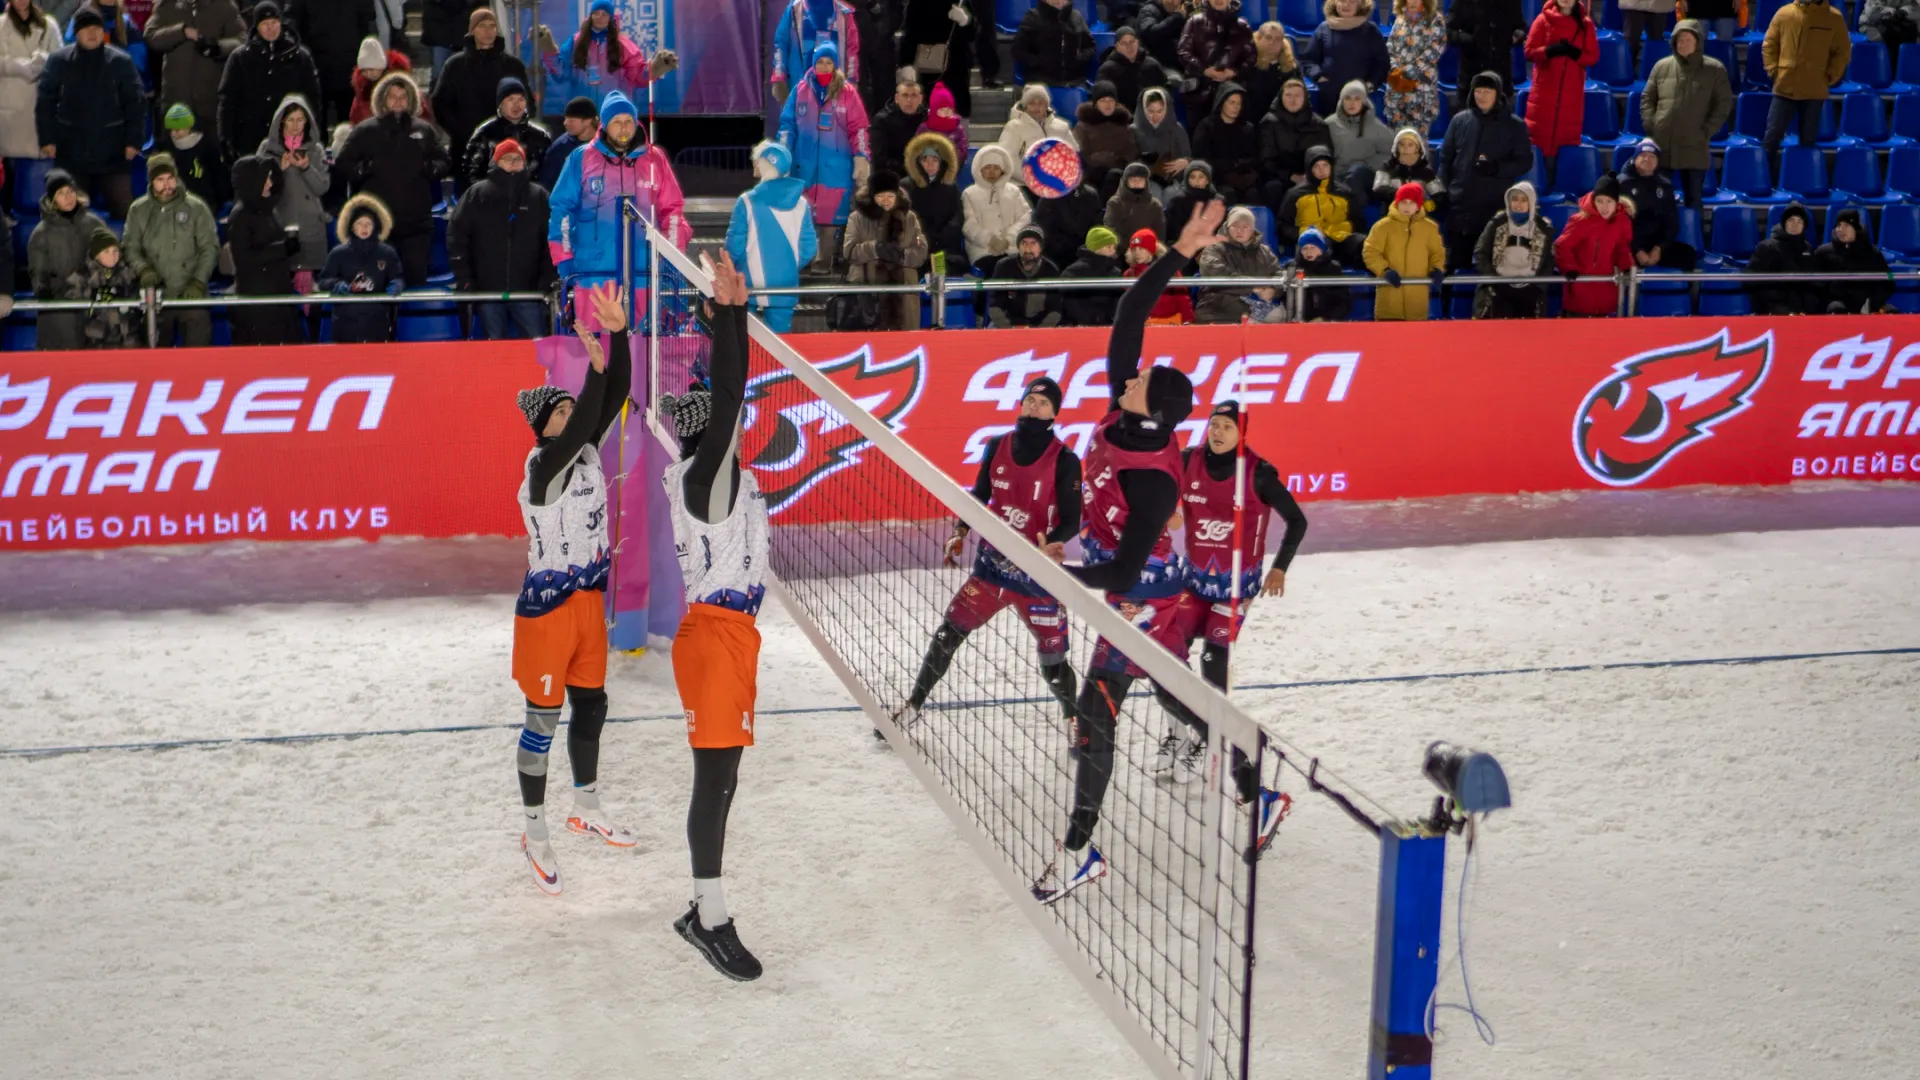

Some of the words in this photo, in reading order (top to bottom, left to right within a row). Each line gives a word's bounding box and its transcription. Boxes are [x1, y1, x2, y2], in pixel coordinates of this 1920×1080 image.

[1796, 399, 1920, 438] ЯМ
[0, 449, 221, 498] МАЛ
[1093, 465, 1112, 489] 2
[1286, 472, 1349, 494] ЛУБ
[1033, 481, 1042, 501] 1
[290, 507, 390, 531] КЛУБ
[540, 674, 553, 696] 1
